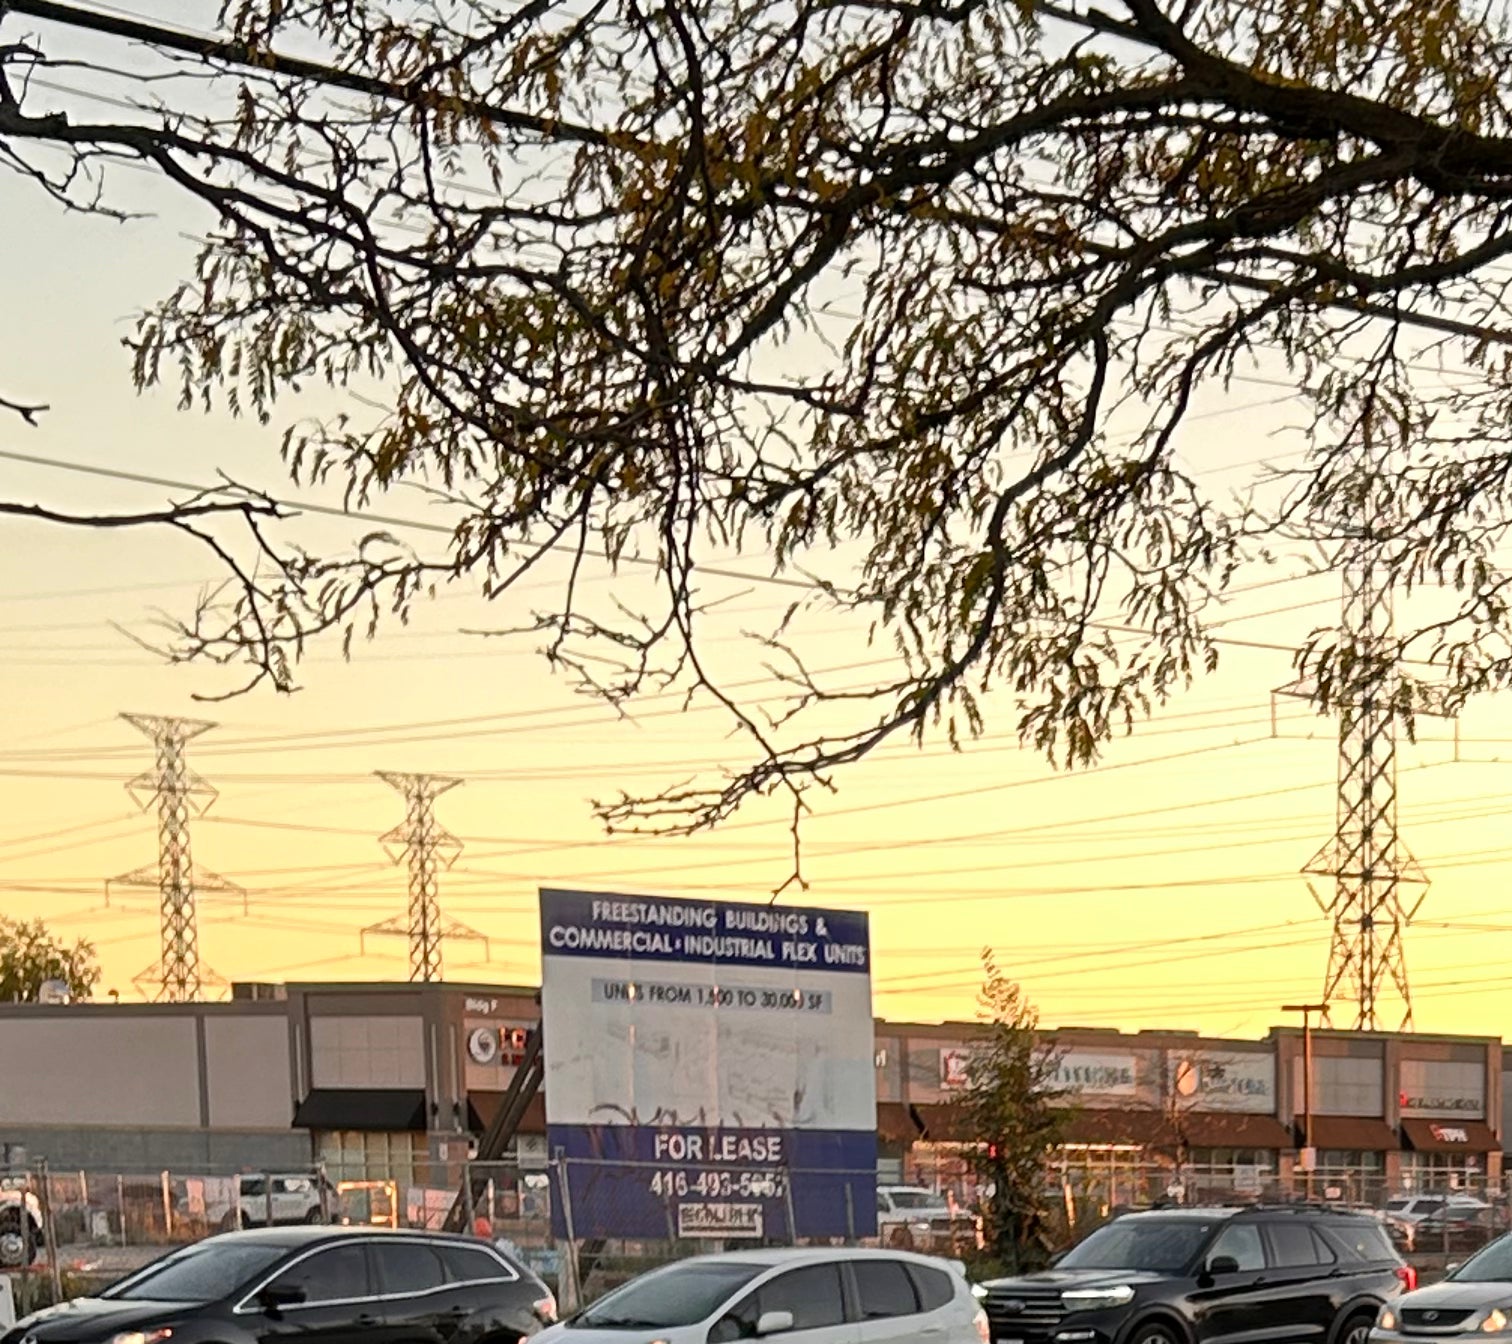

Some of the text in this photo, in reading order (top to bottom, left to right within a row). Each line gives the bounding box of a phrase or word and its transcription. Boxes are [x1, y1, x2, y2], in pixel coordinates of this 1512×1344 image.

[592, 900, 829, 937] FREESTANDING BUILDINGS &
[549, 926, 866, 966] COMMERCIAL INDUSTRIAL FLEX UNITS
[649, 985, 692, 1003] FROM
[737, 990, 756, 1006] TO
[654, 1133, 782, 1162] FOR LEASE
